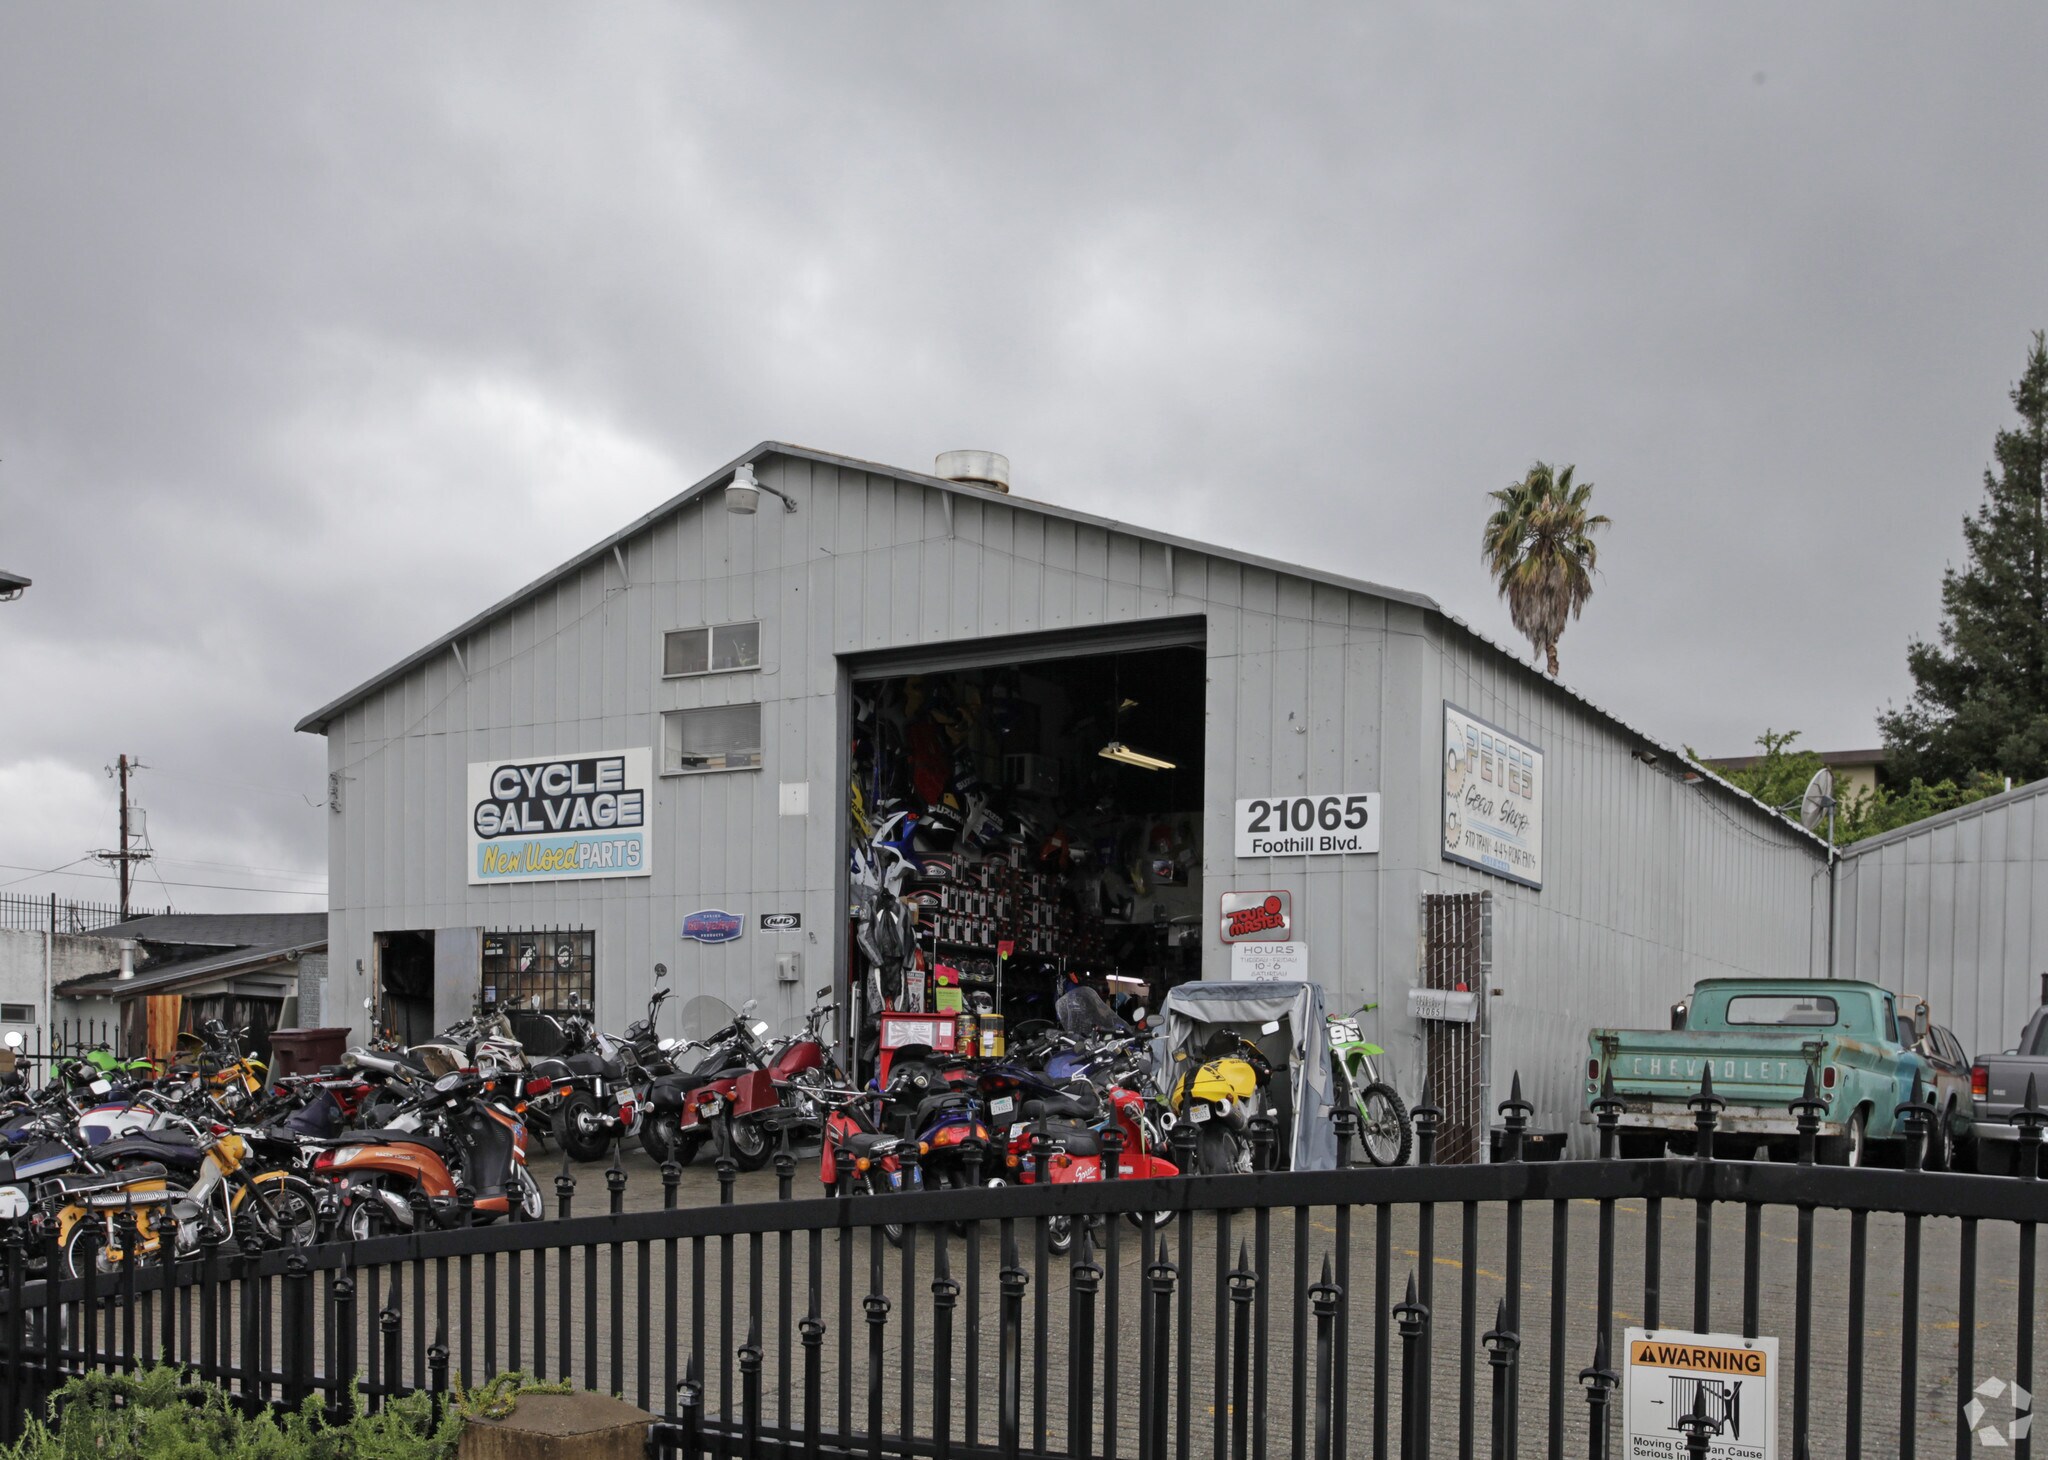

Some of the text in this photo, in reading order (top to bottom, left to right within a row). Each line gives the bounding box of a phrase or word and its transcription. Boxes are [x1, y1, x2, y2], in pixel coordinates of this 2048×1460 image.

[493, 758, 623, 800] CYCLE
[477, 792, 642, 835] SALVAGE
[1247, 796, 1368, 833] 21065
[1499, 799, 1530, 837] Shop
[579, 840, 641, 869] PARTS
[1252, 835, 1362, 853] Foothill Blvd.
[770, 917, 791, 925] HJC
[1226, 906, 1266, 925] TOUR
[1229, 913, 1286, 938] MASTER
[1244, 946, 1294, 954] HOURS
[1255, 962, 1265, 970] 10
[1273, 962, 1281, 970] 6
[1416, 1007, 1440, 1016] 21065
[1330, 1025, 1361, 1045] 95
[1658, 1346, 1761, 1373] WARNING
[1633, 1436, 1672, 1451] Moving
[1711, 1447, 1725, 1455] an
[1728, 1447, 1763, 1459] Cause
[1633, 1447, 1674, 1460] Serious
